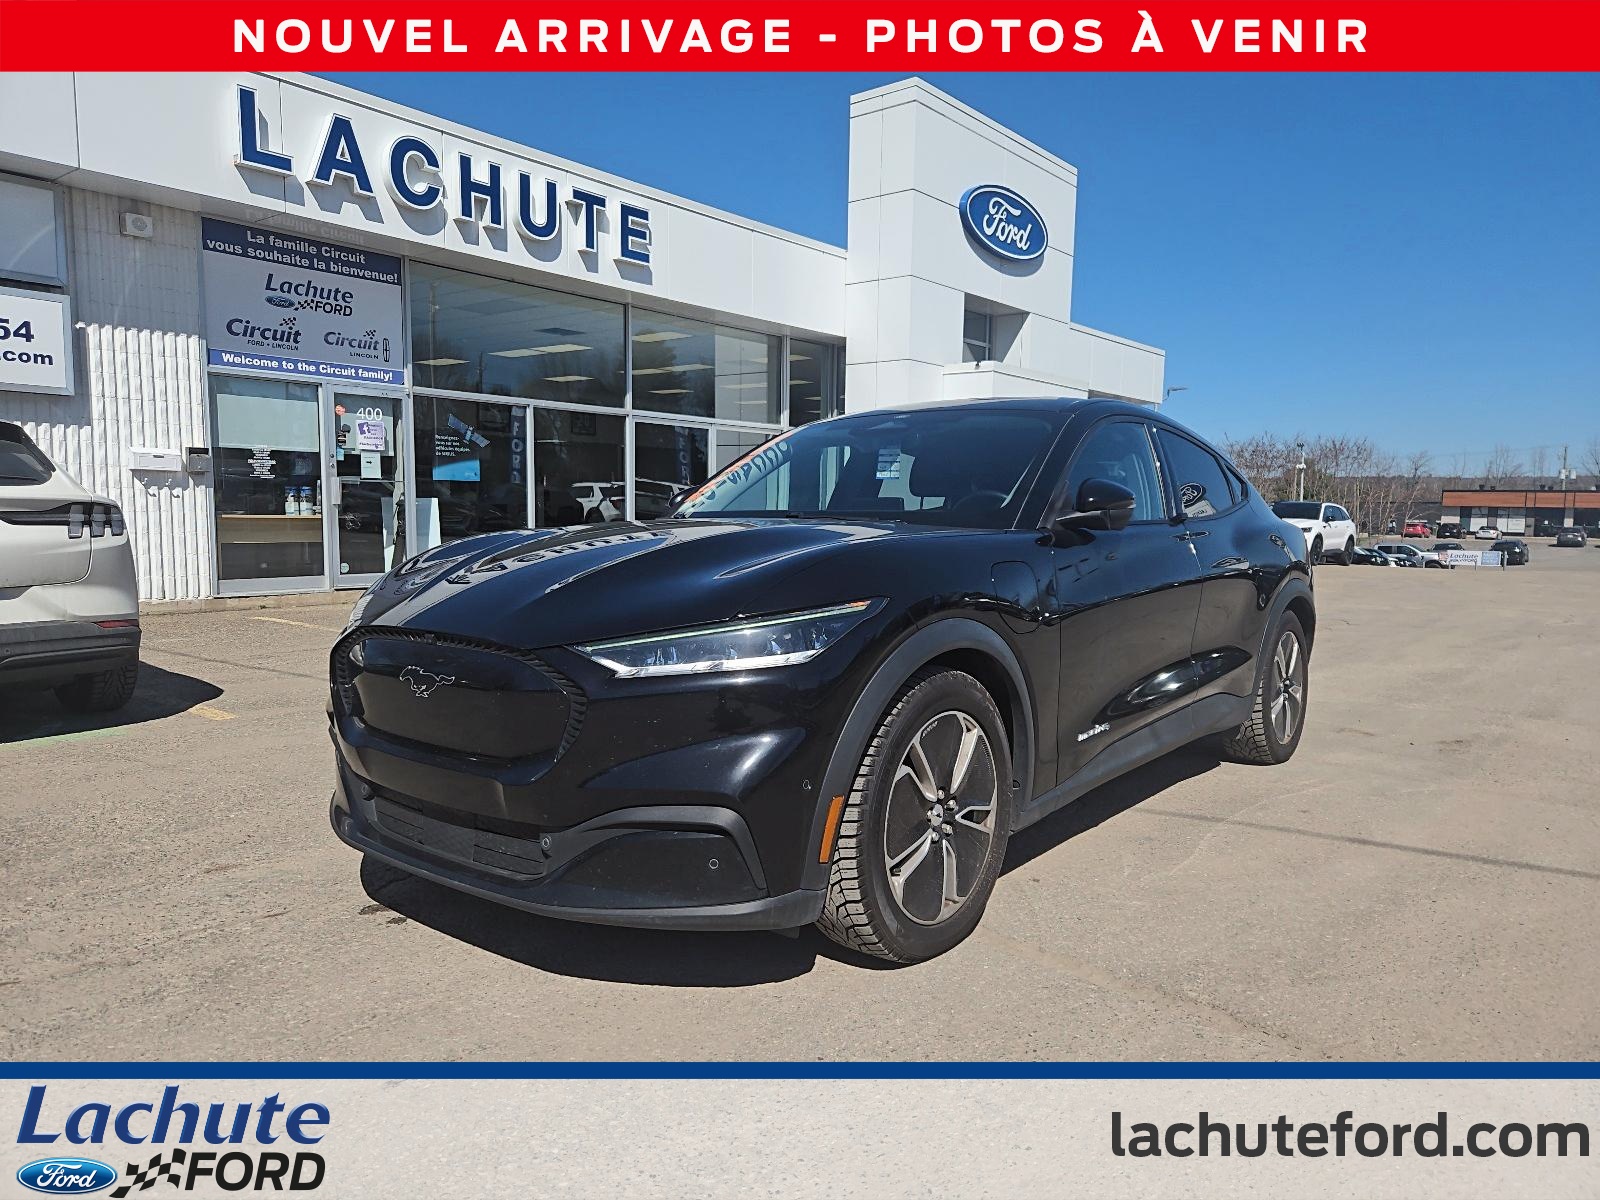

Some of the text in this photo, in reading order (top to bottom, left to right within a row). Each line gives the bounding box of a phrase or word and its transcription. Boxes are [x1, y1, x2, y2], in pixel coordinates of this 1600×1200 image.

[235, 84, 651, 266] LACHUTE
[982, 196, 1033, 252] Ford
[206, 239, 398, 283] vous souhaite la bienvenue!
[247, 230, 366, 264] La famille Circuit
[265, 273, 354, 304] Lachute
[315, 300, 353, 317] FORD
[226, 317, 302, 345] Circuit
[247, 339, 299, 351] FORD LINCOLN
[323, 331, 380, 352] Circuit
[222, 352, 393, 382] Welcome to the Circuit family!
[356, 407, 383, 421] 400
